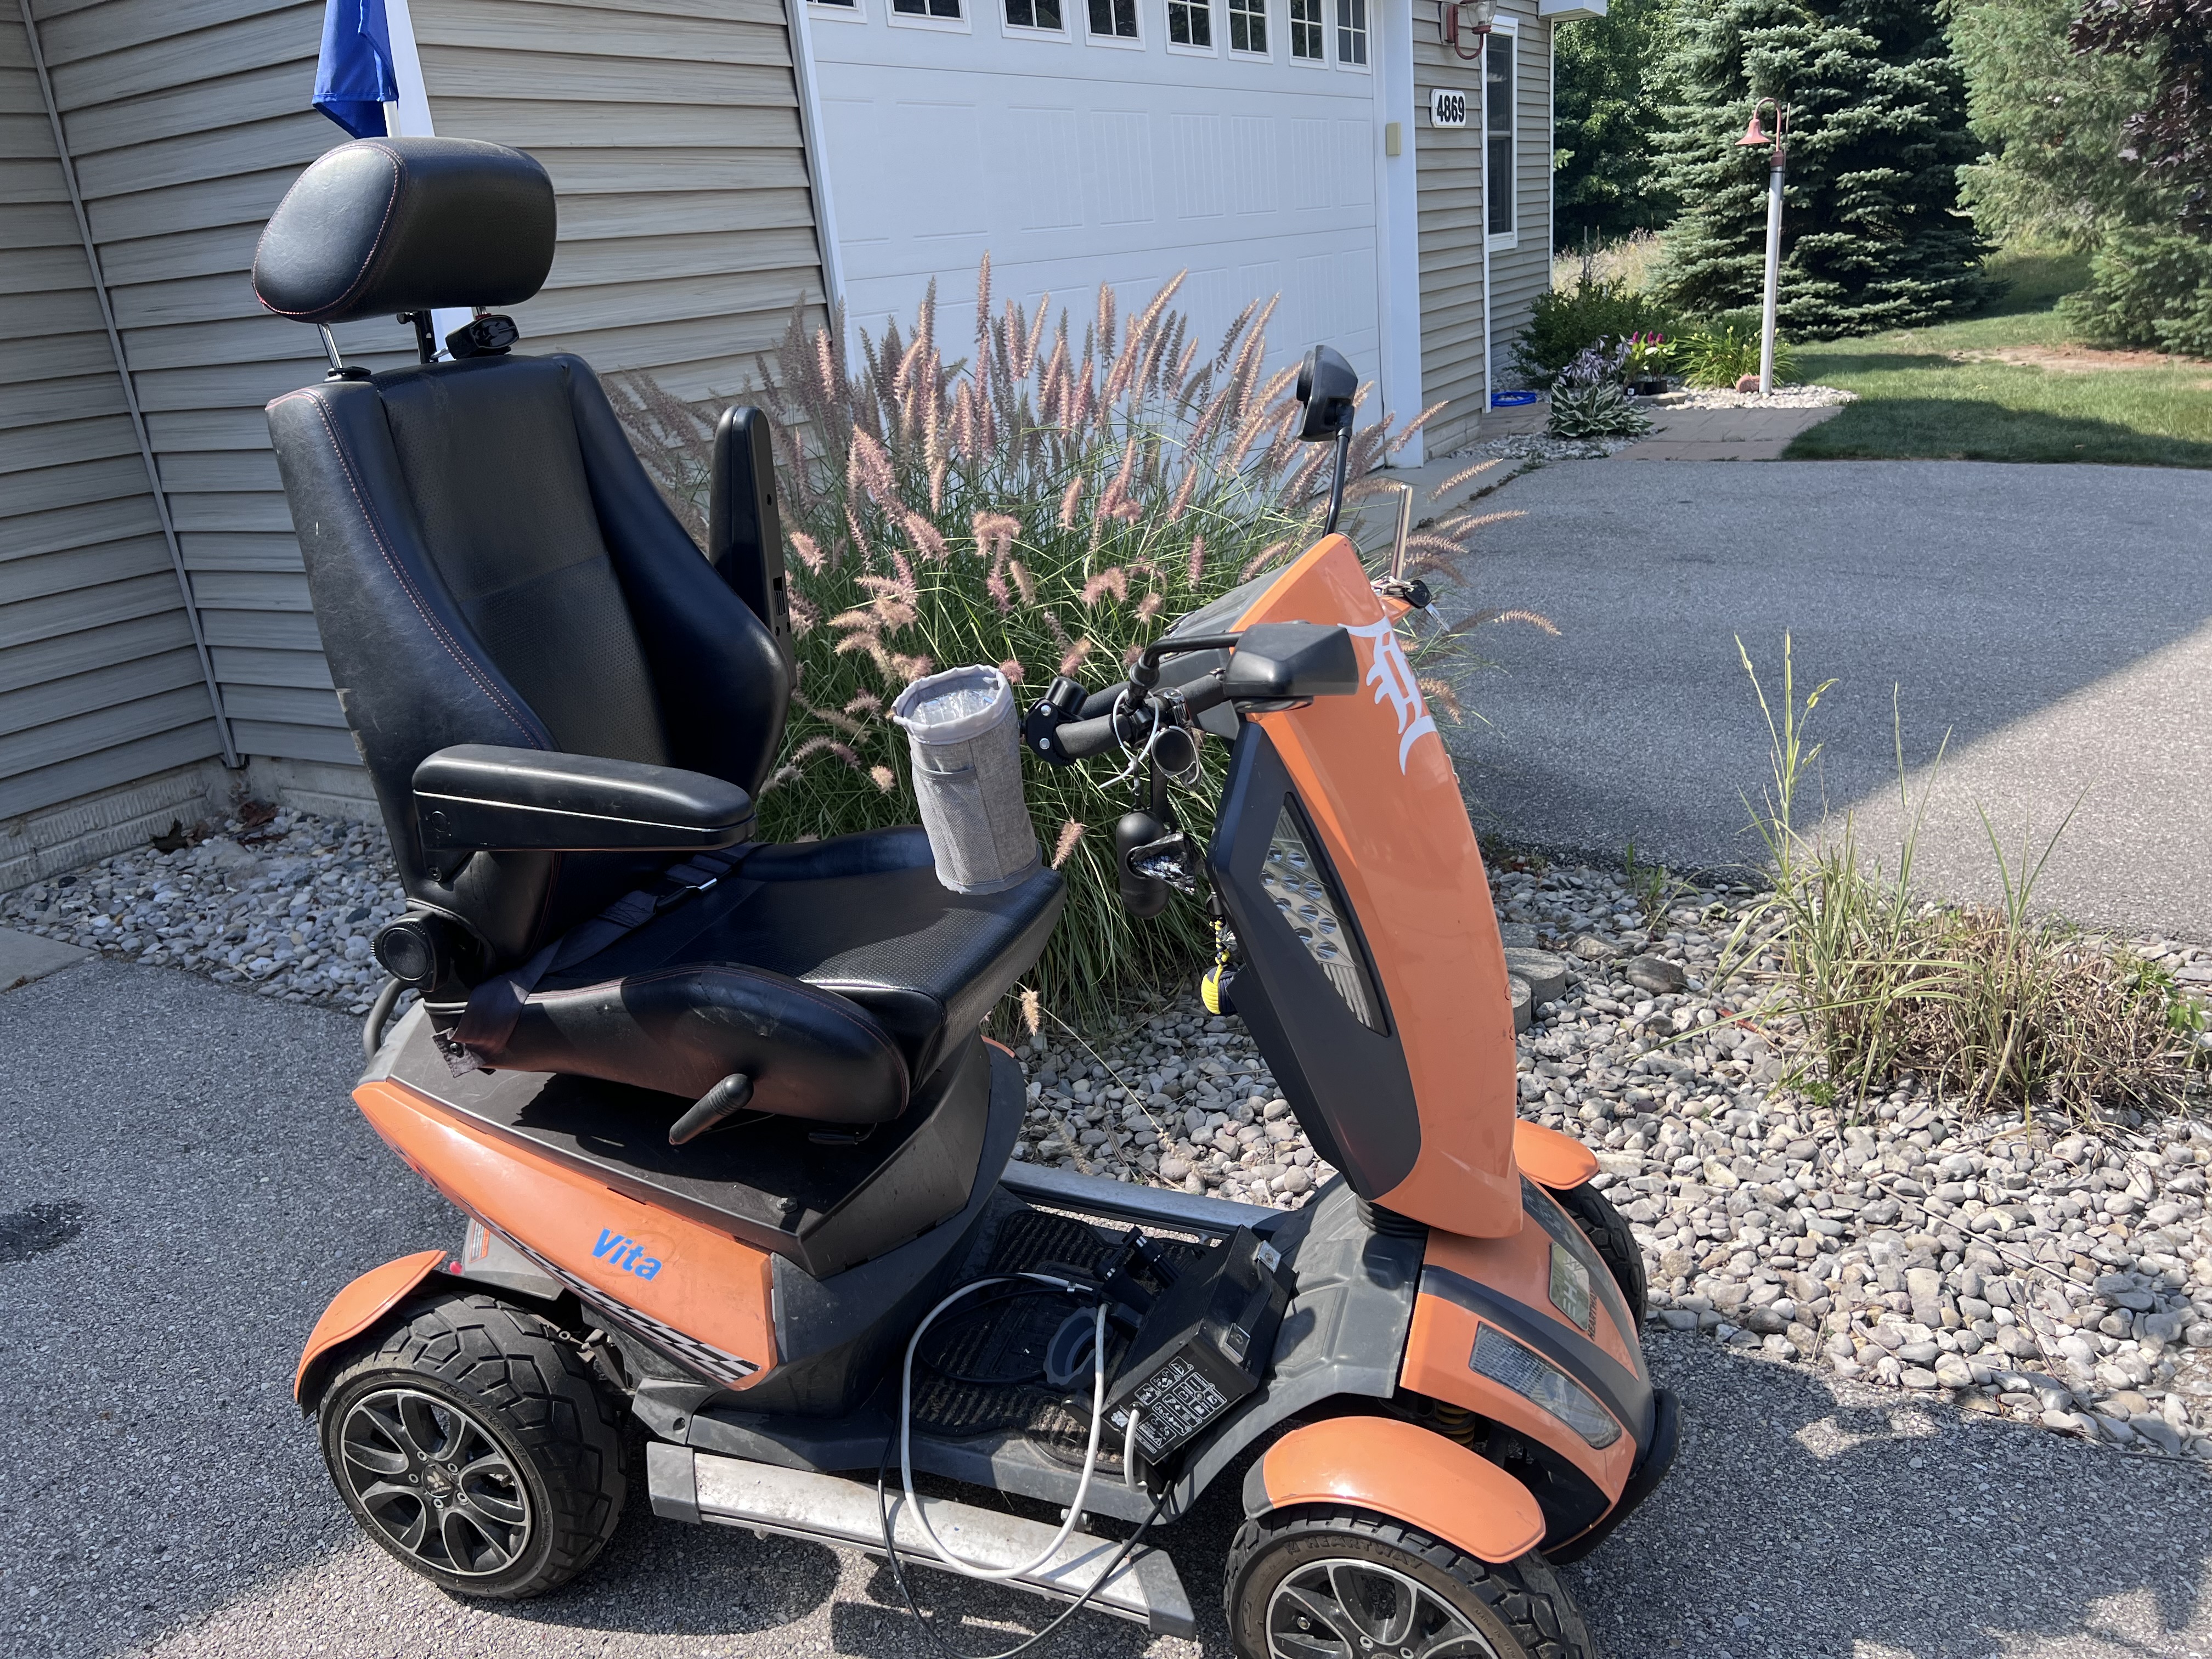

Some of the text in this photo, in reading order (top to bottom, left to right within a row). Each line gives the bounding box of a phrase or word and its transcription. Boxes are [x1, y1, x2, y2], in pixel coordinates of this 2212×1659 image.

[1437, 94, 1465, 122] 4869
[592, 1228, 662, 1282] Vita
[1304, 1536, 1423, 1570] HEARTWAY
